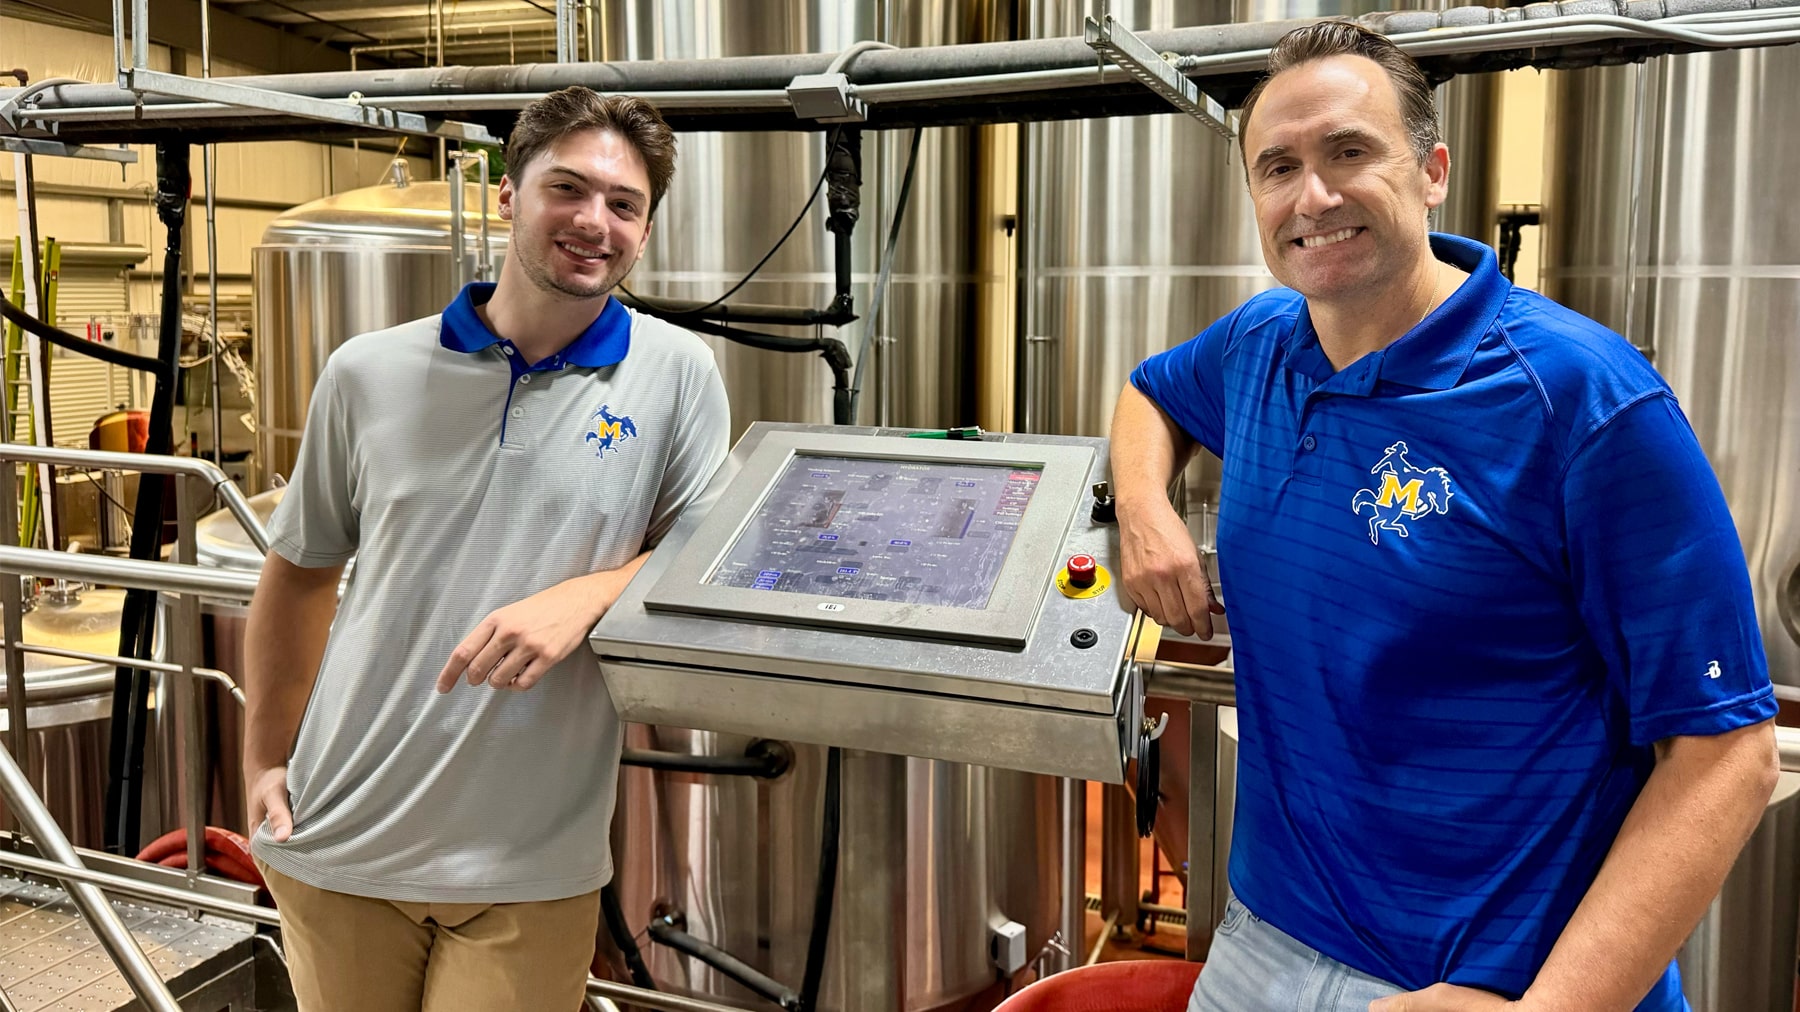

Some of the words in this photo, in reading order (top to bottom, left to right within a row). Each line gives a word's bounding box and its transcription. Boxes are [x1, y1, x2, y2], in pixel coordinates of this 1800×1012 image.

[598, 420, 622, 440] M
[1376, 473, 1424, 513] M
[1092, 585, 1106, 595] STOP
